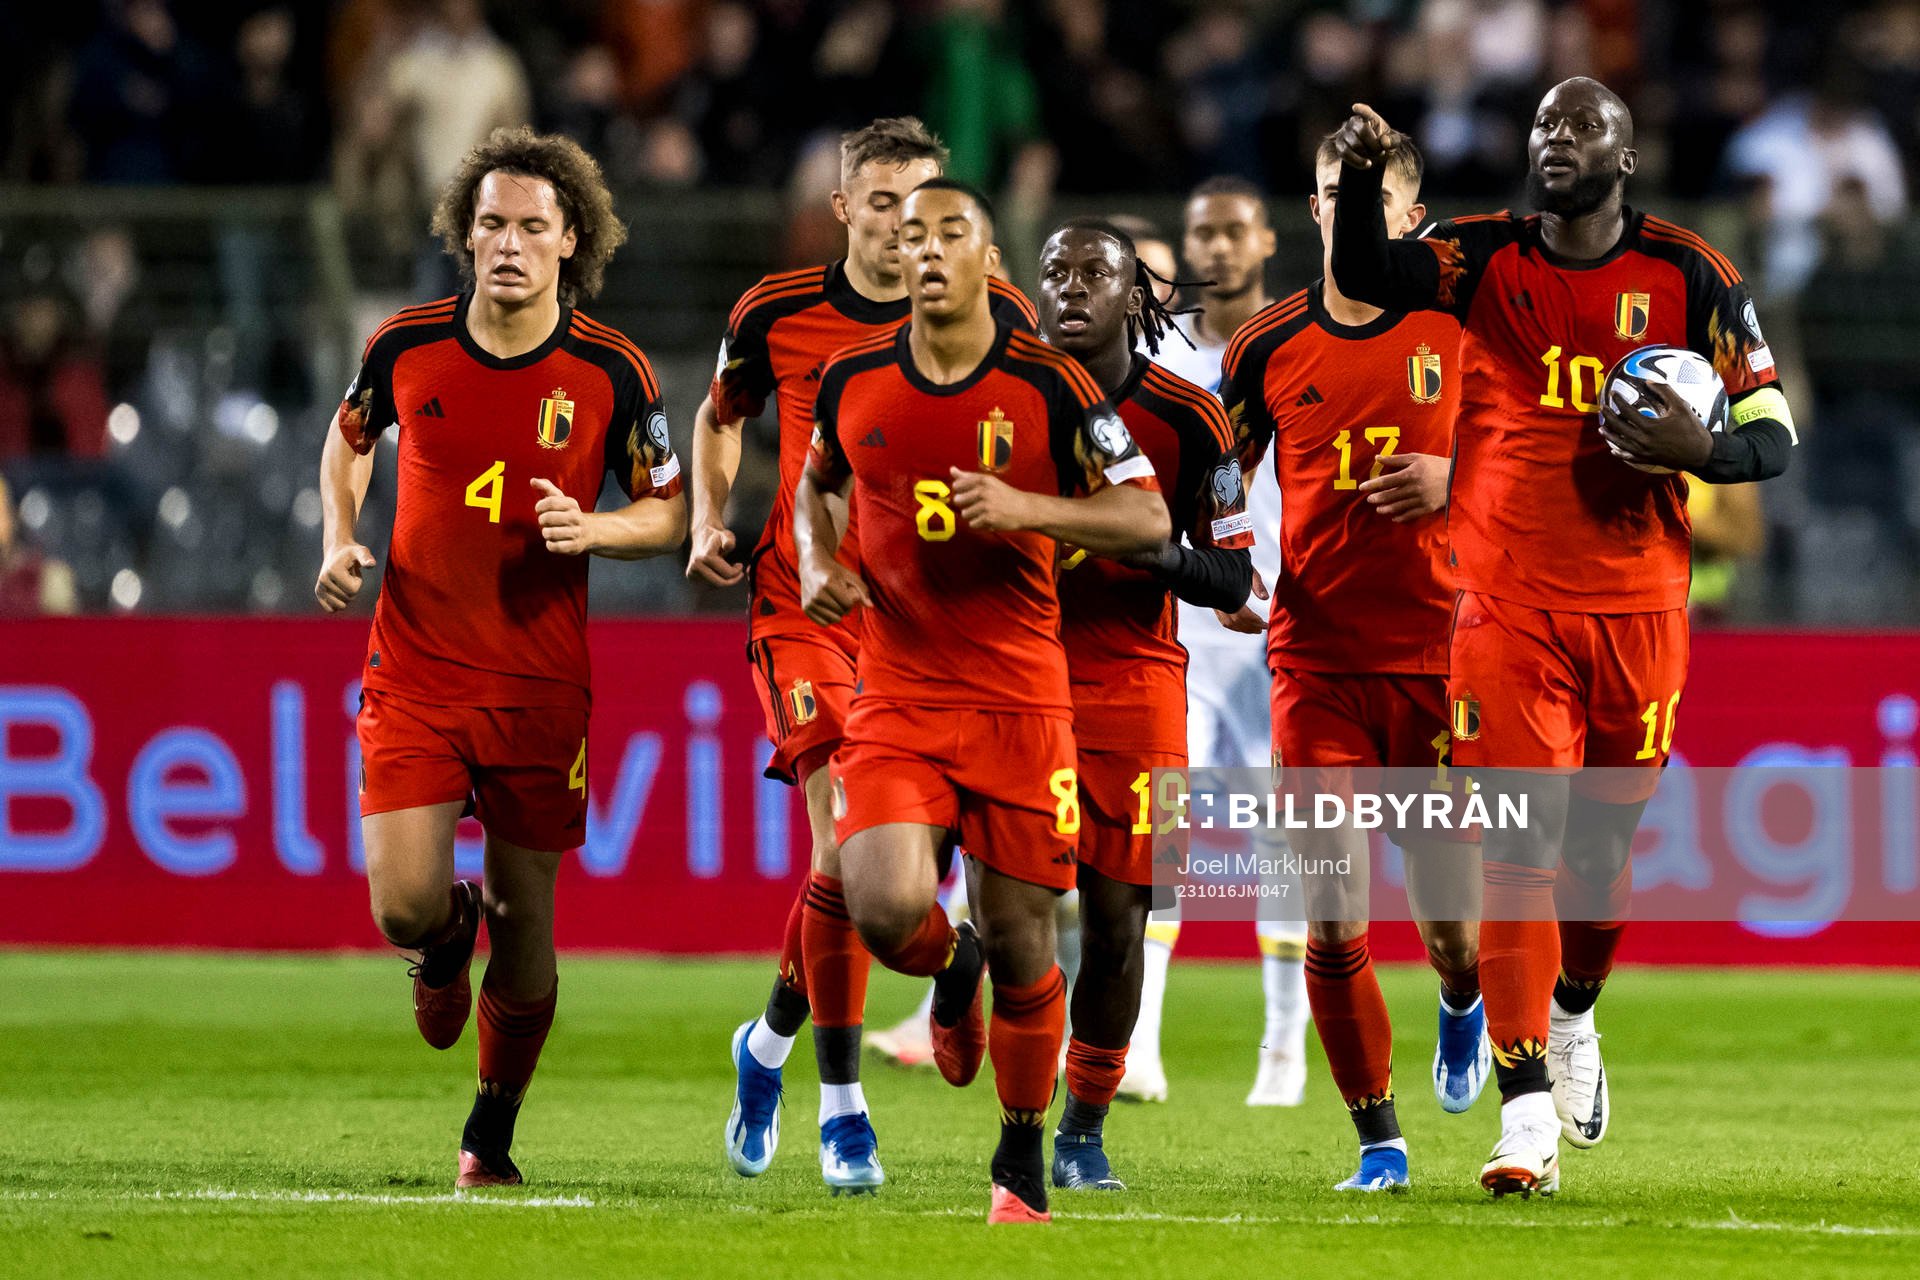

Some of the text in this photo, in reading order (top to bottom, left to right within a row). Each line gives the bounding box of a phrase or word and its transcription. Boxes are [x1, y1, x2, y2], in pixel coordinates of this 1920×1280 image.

[1539, 345, 1605, 413] 10
[1332, 426, 1401, 490] 17
[464, 460, 506, 524] 4
[913, 479, 956, 542] 8
[568, 736, 586, 800] 4
[1049, 767, 1081, 834] 8
[1129, 772, 1187, 835] 19
